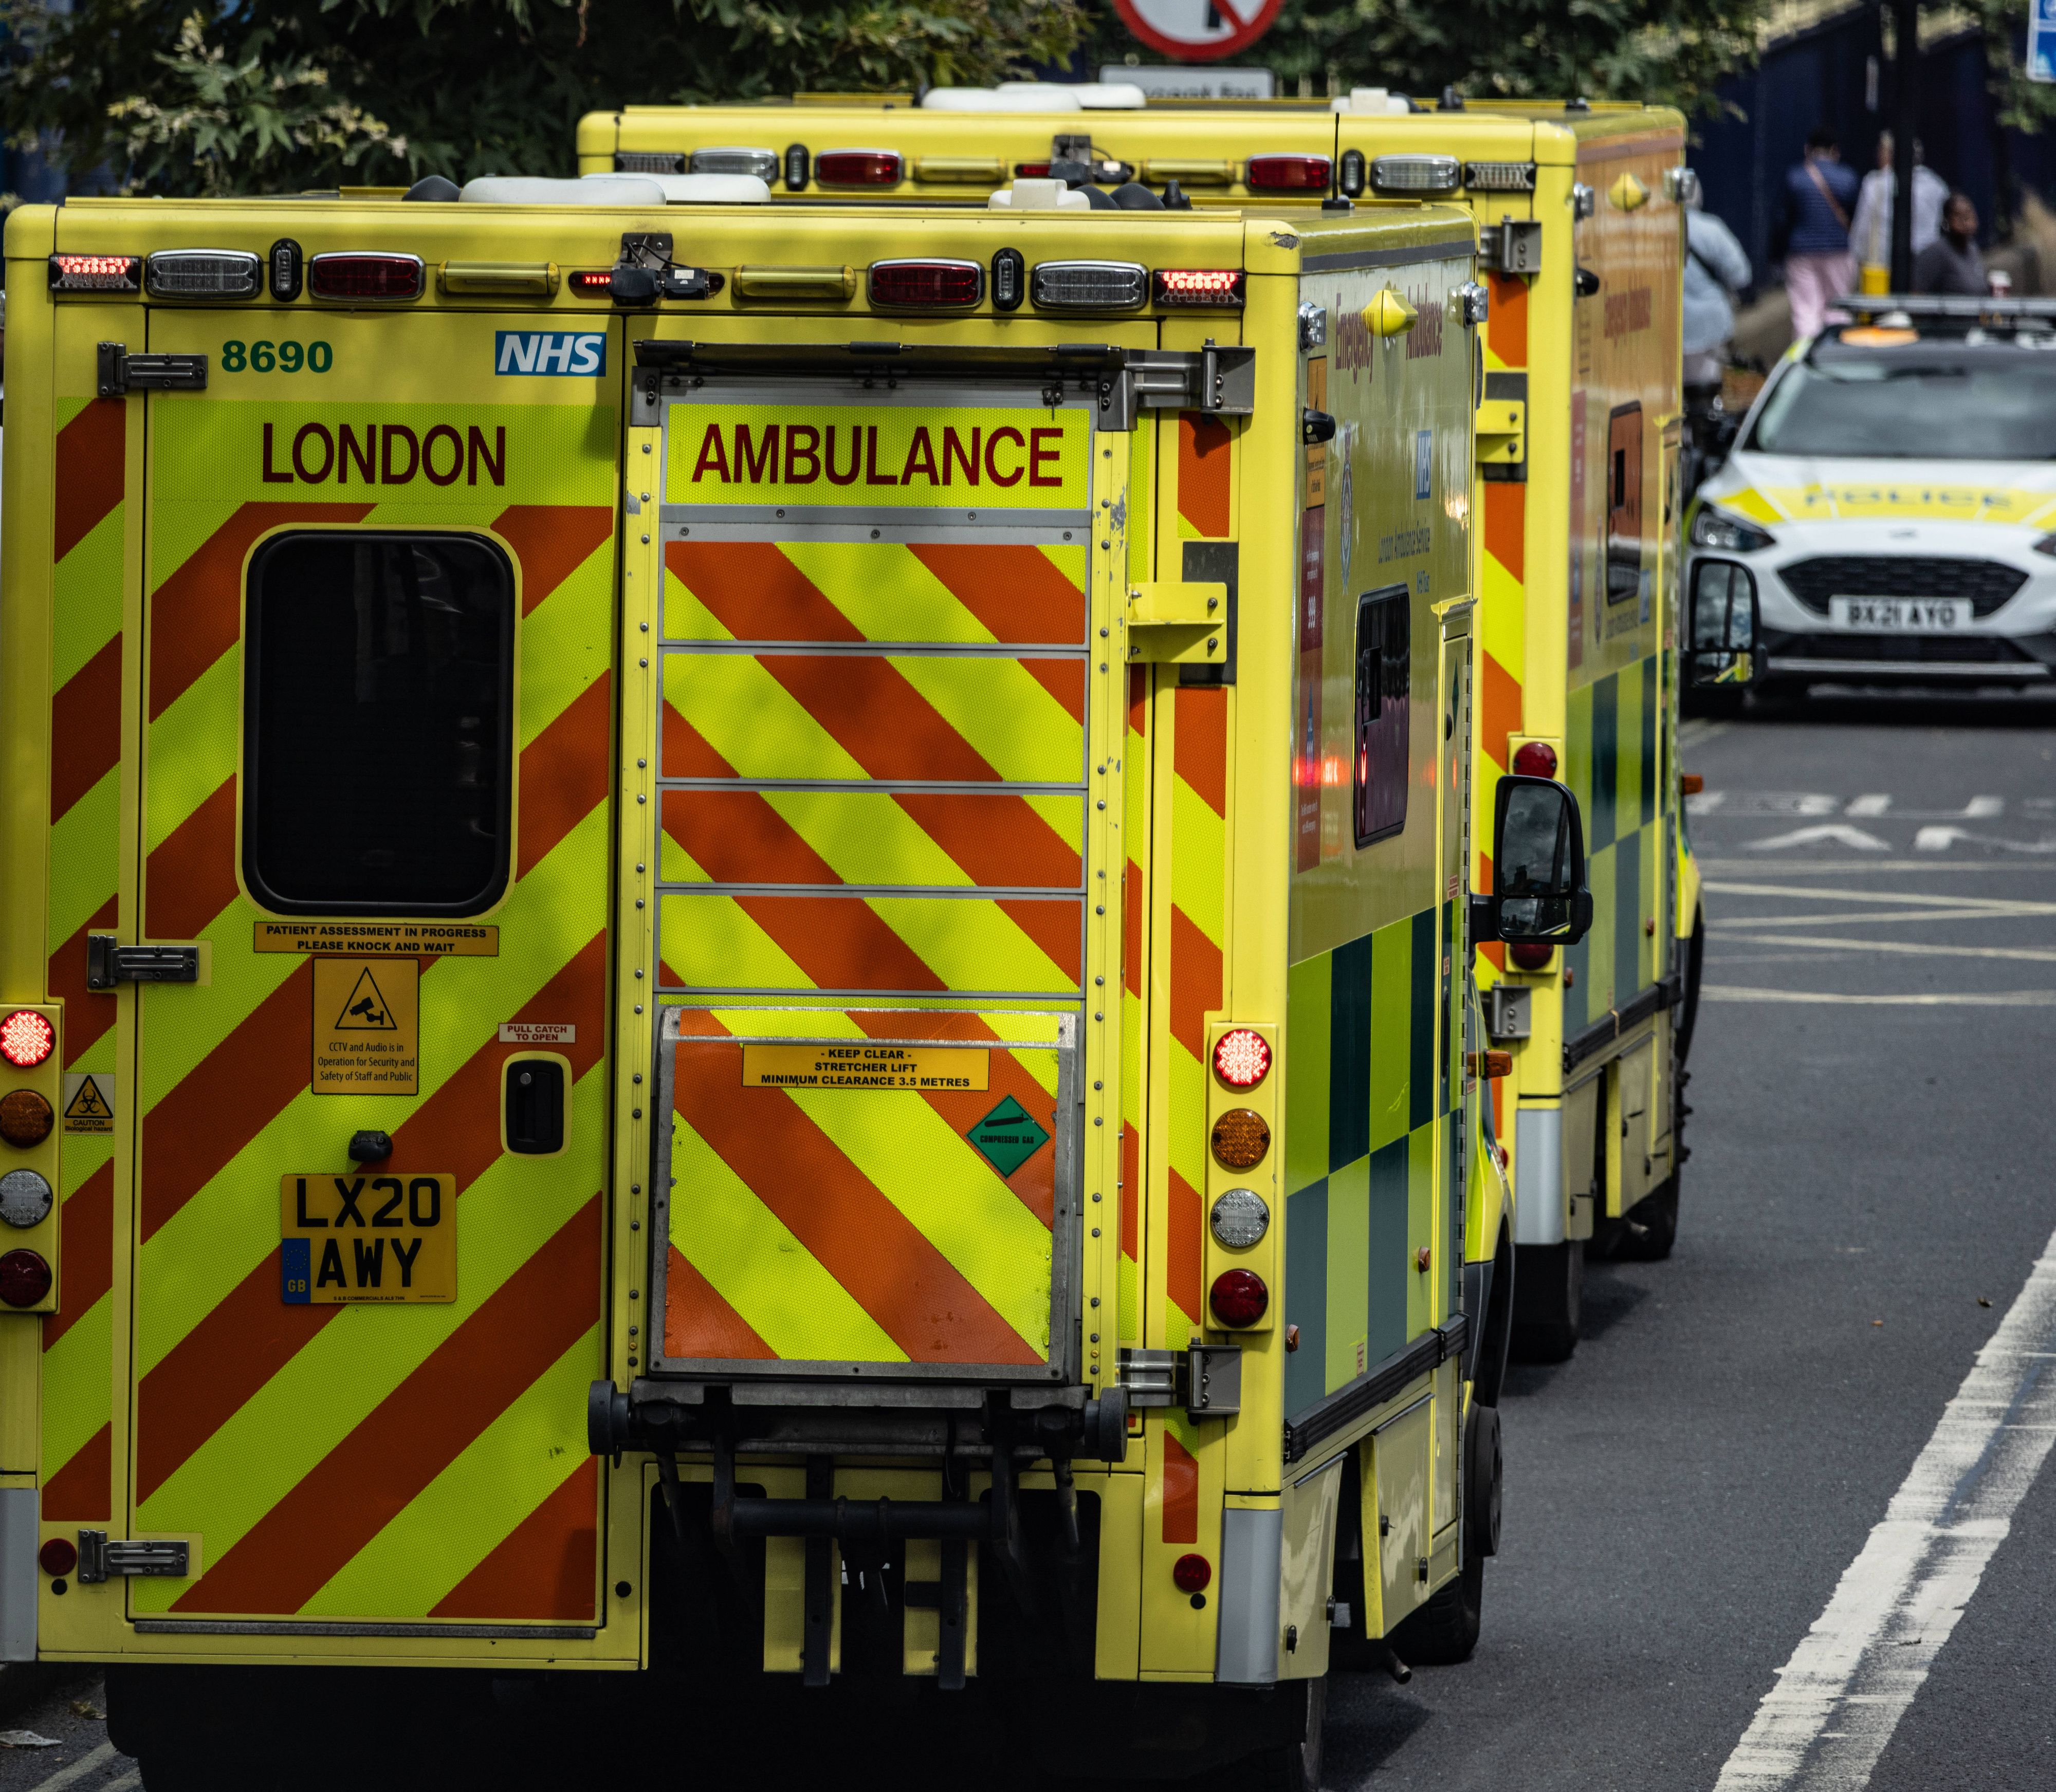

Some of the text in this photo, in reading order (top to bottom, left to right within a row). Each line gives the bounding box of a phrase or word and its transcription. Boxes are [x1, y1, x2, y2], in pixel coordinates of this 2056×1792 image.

[1335, 292, 1374, 384] Emergency
[221, 340, 333, 373] 8690
[498, 334, 603, 373] NHS
[263, 422, 1064, 487] LONDON AMBULANCE
[1417, 436, 1431, 494] NHS
[1805, 489, 2012, 506] POLICE
[266, 926, 487, 938] PATIENT ASSESSMENT IN PROGRESS
[298, 940, 455, 952] PLEASE KNOCK AND WAIT
[329, 1042, 403, 1052] CCTV and Audio is in
[828, 1049, 861, 1059] KEEP
[864, 1050, 904, 1059] CLEAR
[318, 1057, 414, 1068] Operation for Security and
[815, 1062, 917, 1072] STRETCHER LIFT
[320, 1071, 412, 1082] Safety of Staff and Public
[761, 1075, 970, 1087] MINIMUM CLEARANCE 3.5 METRES
[980, 1135, 1034, 1144] COMPRESSED GAS
[297, 1177, 440, 1228] LX20
[316, 1237, 423, 1288] AWY
[287, 1279, 306, 1293] GB
